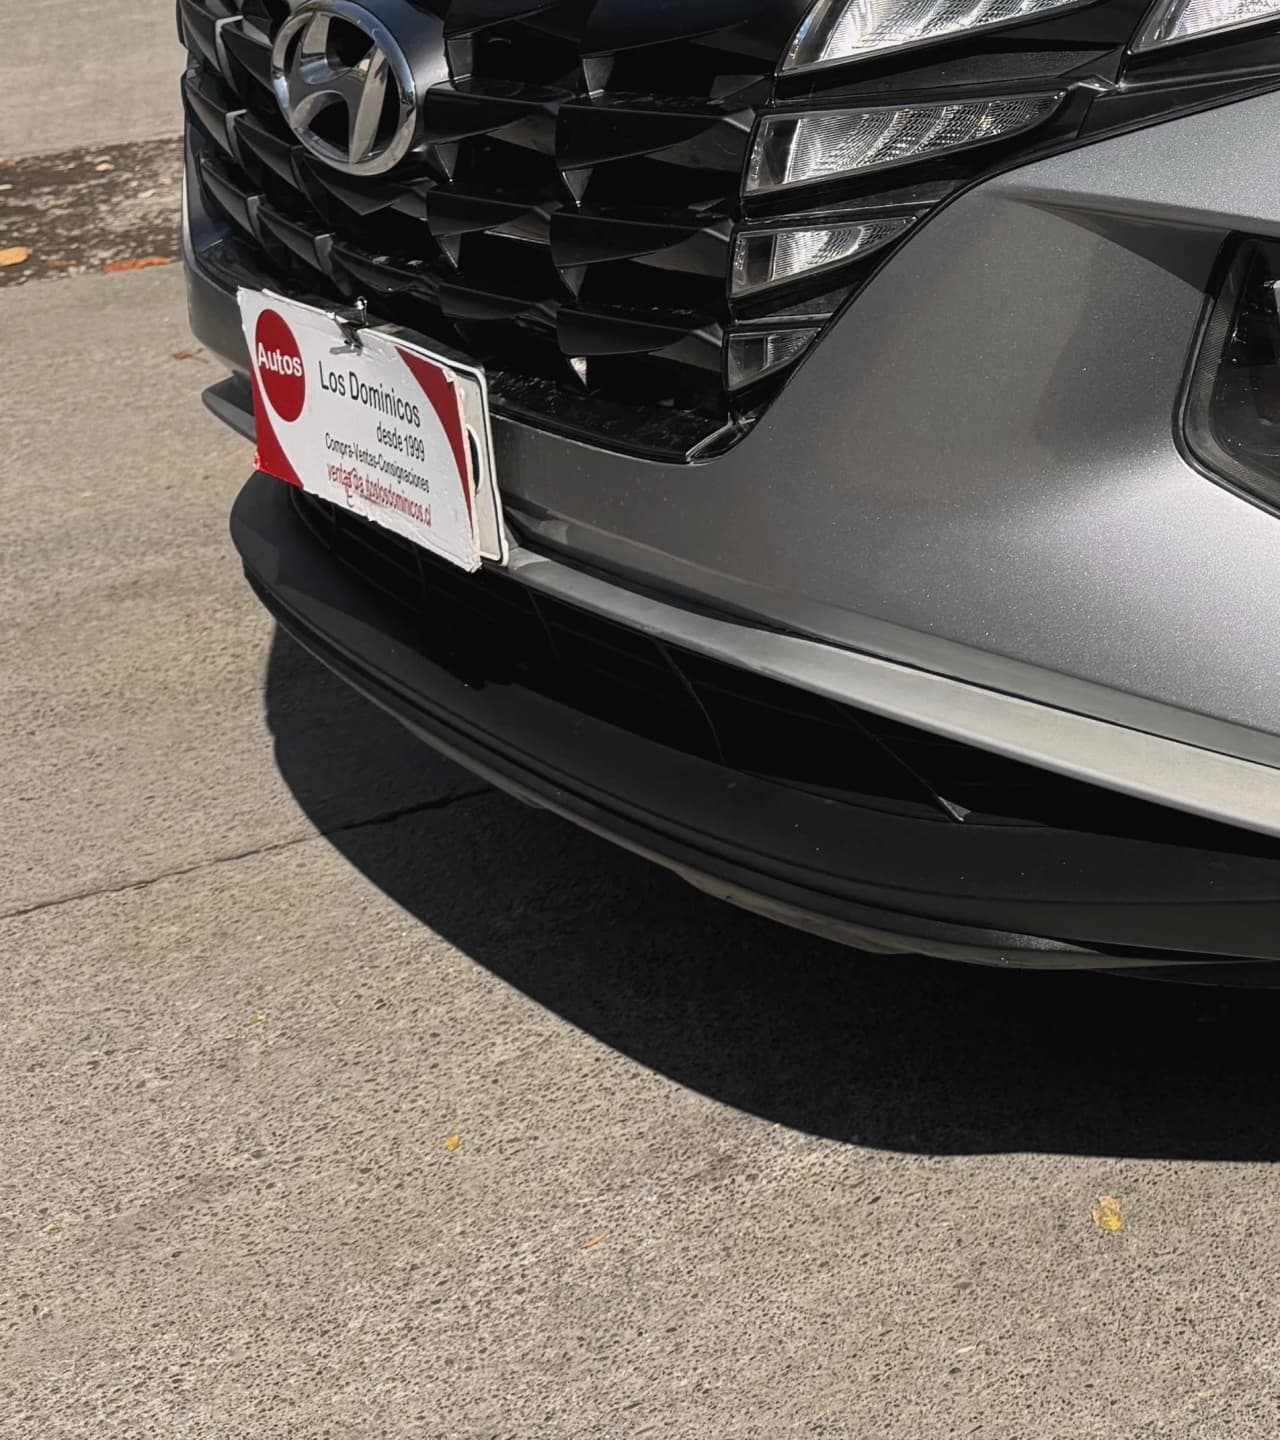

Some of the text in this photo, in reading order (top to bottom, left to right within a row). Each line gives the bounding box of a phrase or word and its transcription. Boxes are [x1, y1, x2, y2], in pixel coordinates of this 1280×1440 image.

[256, 342, 303, 377] Autos
[318, 360, 421, 428] Los Dominicos
[376, 421, 425, 463] desde 1999
